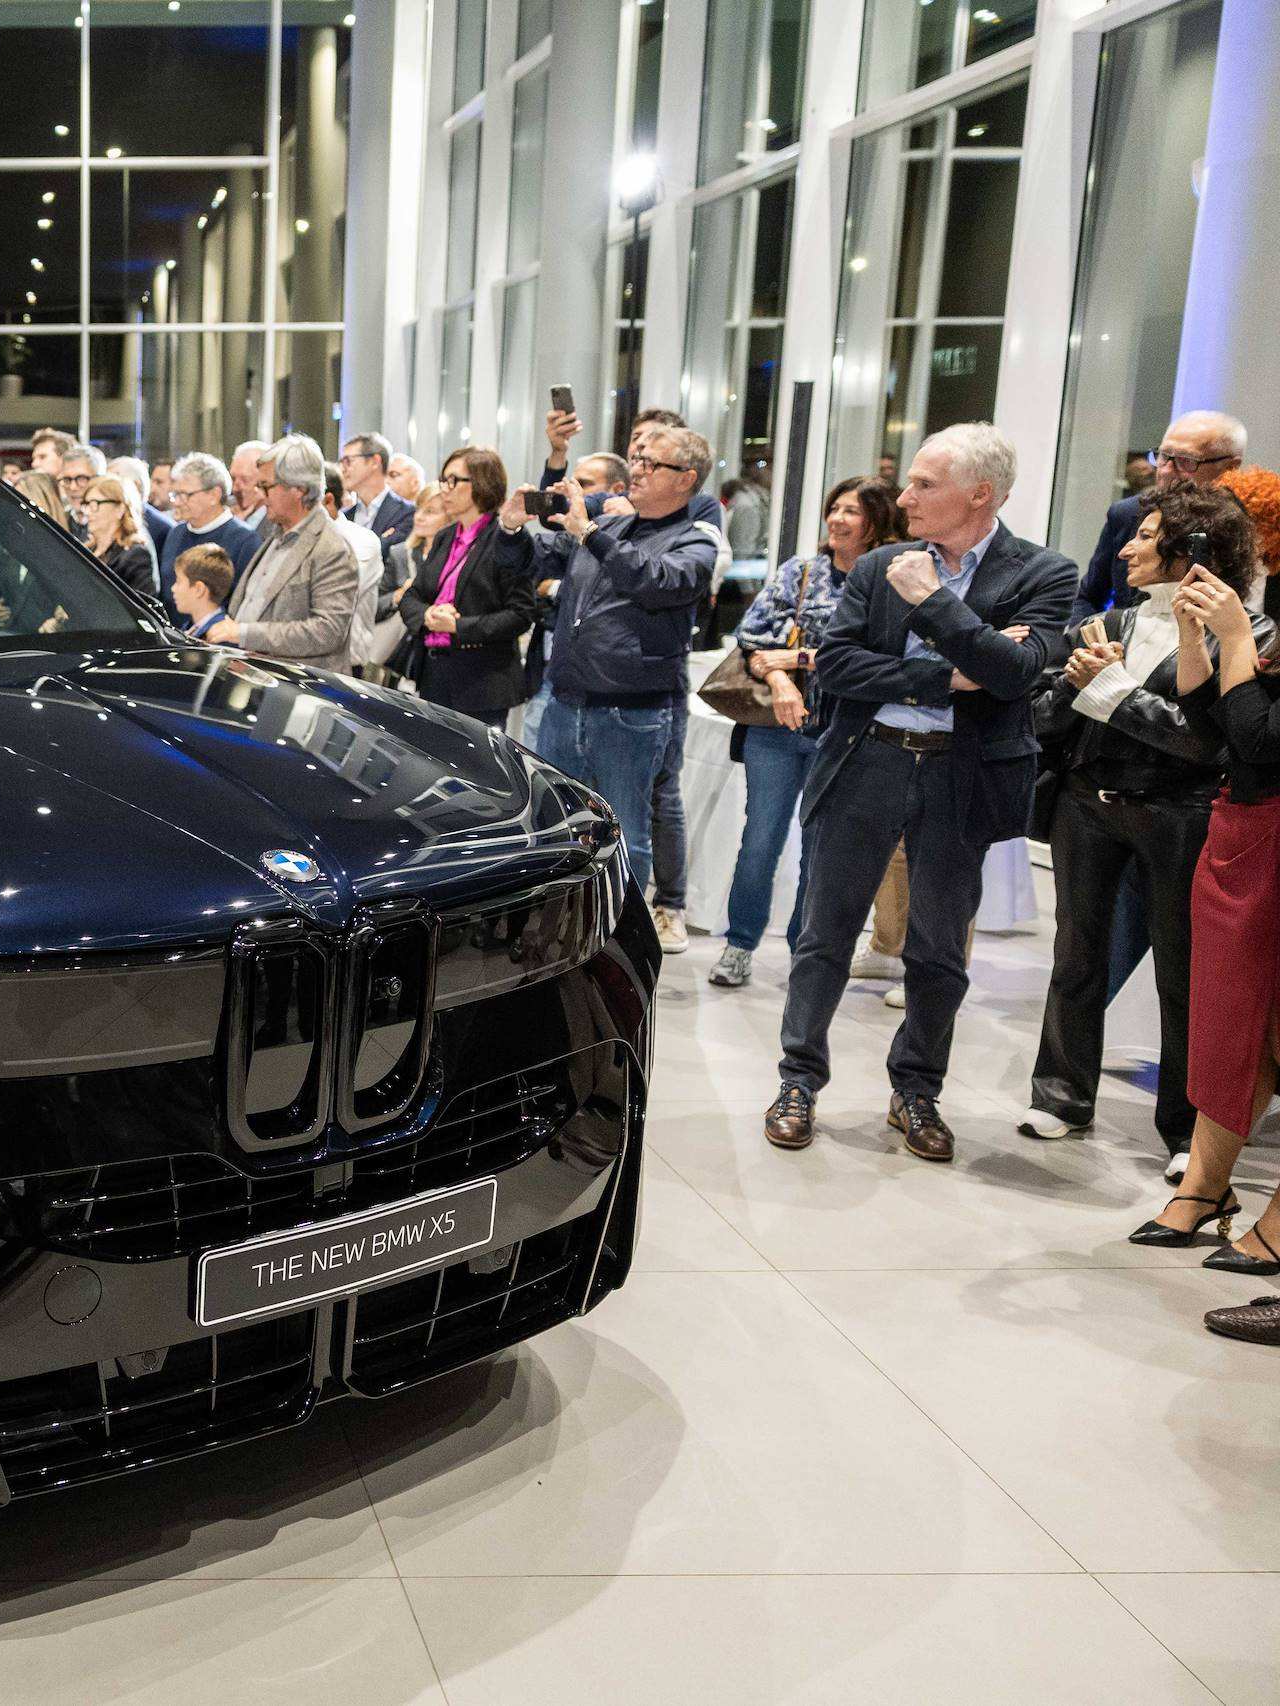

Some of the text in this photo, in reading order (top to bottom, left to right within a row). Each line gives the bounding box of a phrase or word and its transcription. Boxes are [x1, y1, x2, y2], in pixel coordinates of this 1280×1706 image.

[251, 1209, 456, 1288] THE NEW BMW X5
